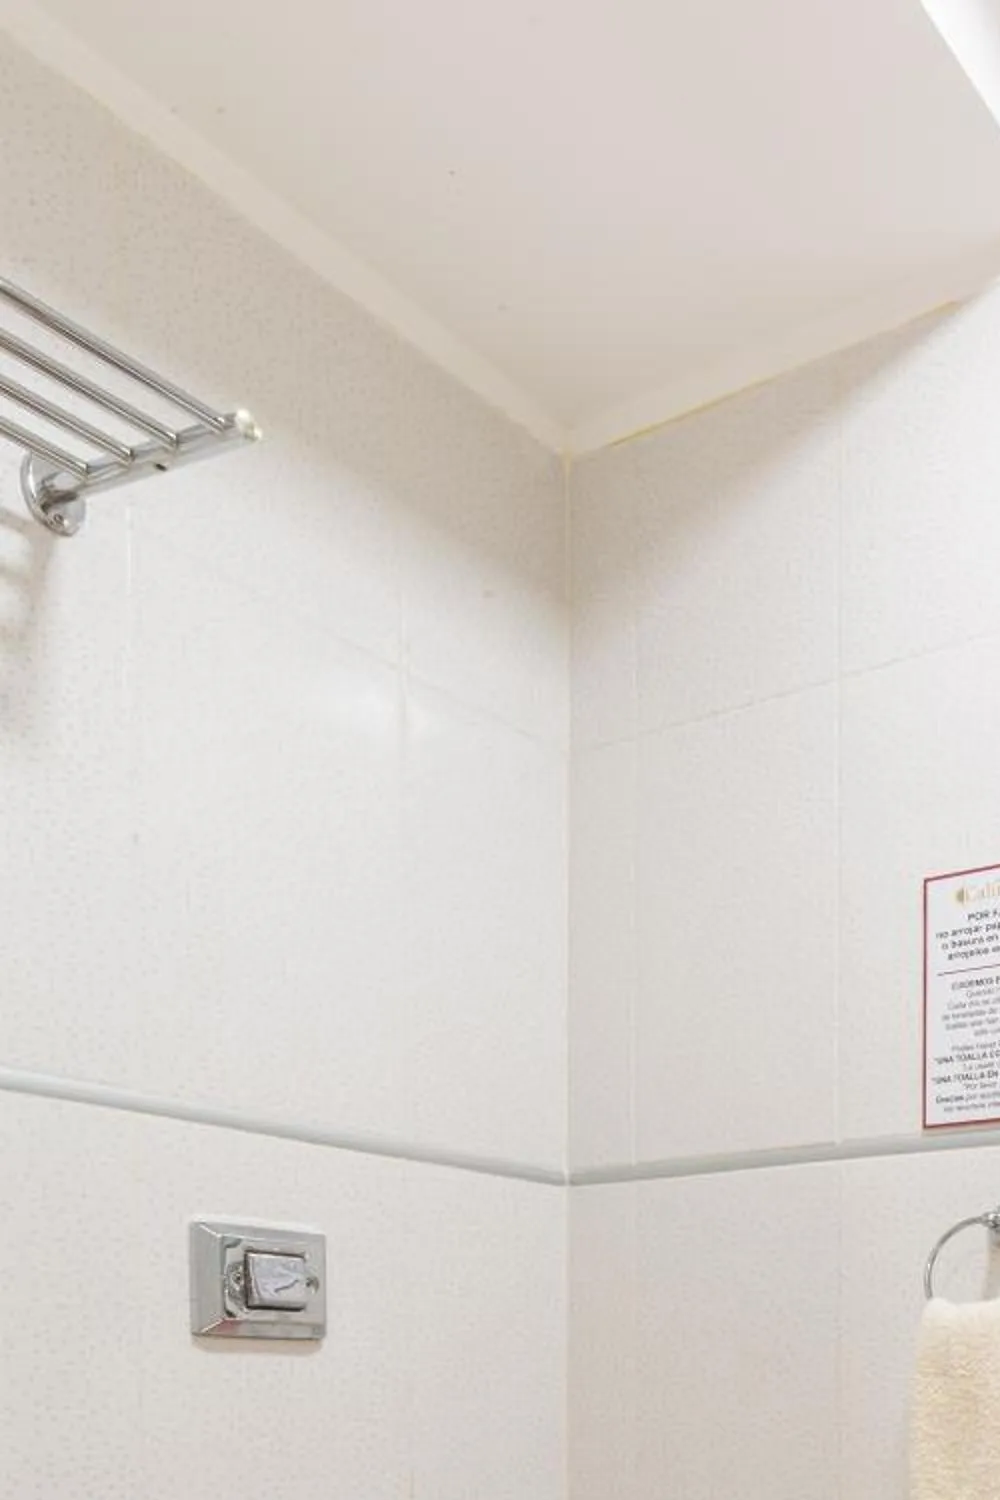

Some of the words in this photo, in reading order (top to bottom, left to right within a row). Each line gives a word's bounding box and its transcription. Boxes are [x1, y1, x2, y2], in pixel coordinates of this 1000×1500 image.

[967, 909, 990, 921] POR
[935, 930, 948, 939] no
[950, 924, 982, 938] arrojar
[951, 935, 984, 948] basura
[985, 933, 998, 942] en
[955, 1051, 986, 1062] TOALLA
[953, 1071, 984, 1081] TOALLA
